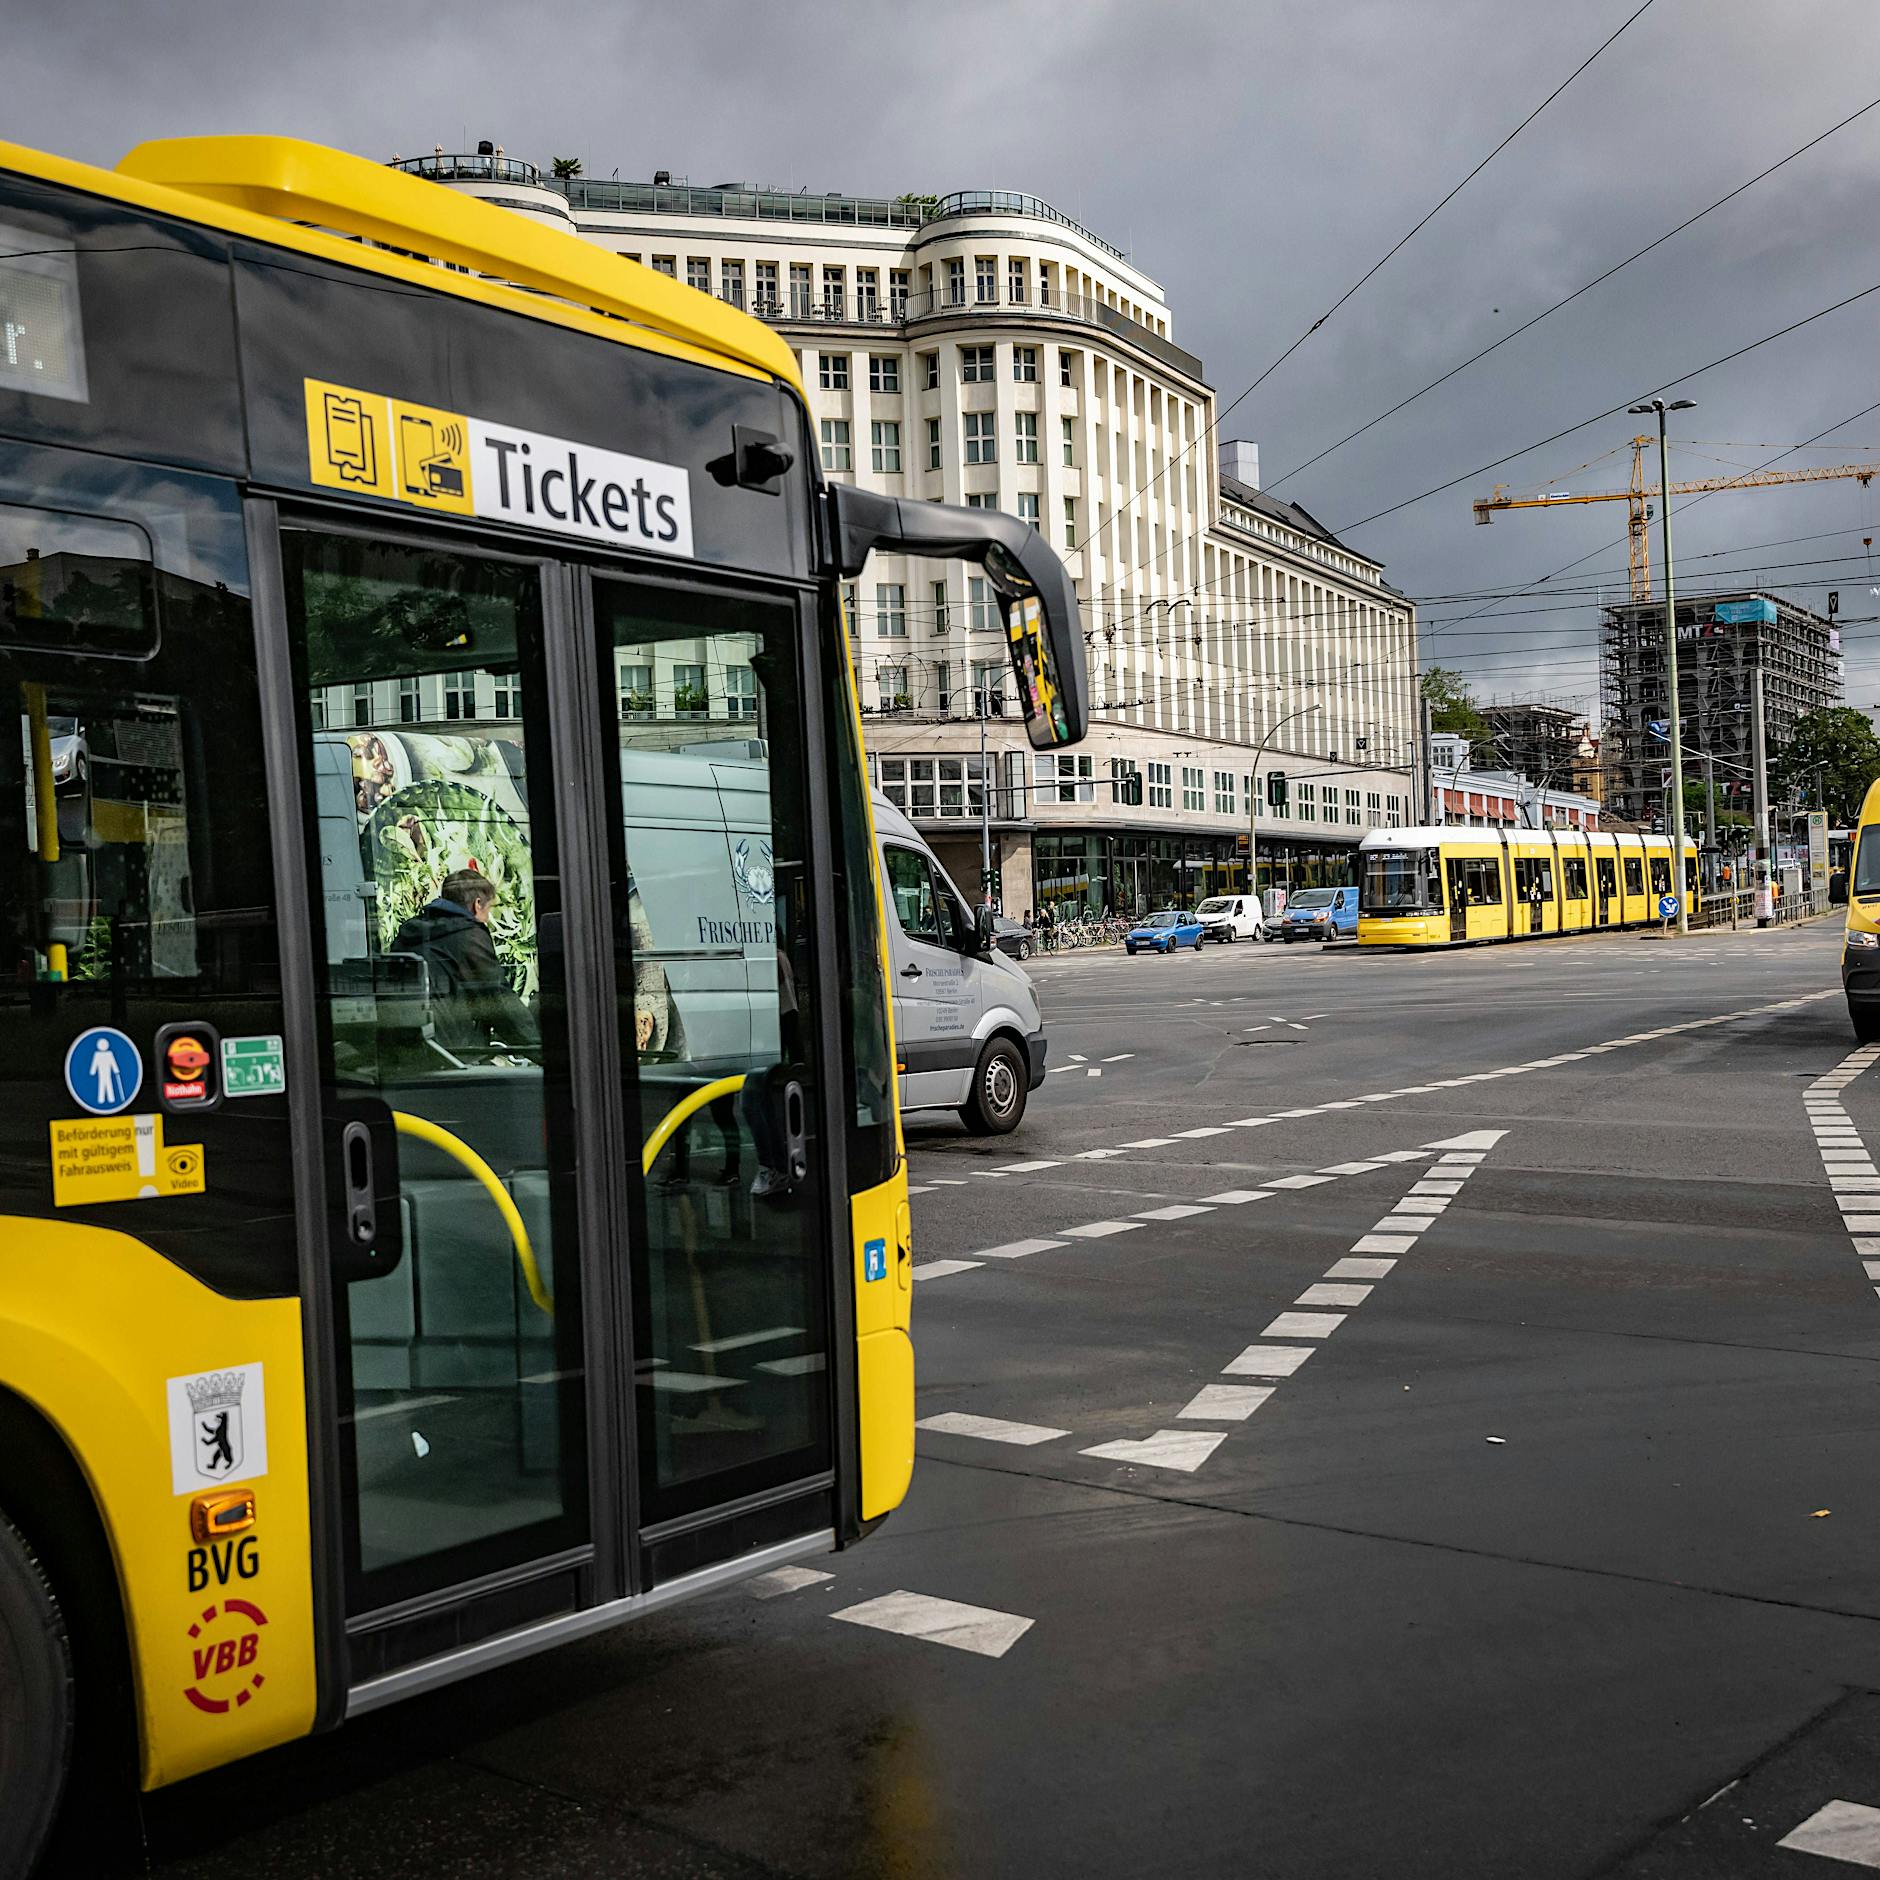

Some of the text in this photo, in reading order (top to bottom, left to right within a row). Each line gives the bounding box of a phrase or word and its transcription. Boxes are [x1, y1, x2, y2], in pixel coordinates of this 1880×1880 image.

[485, 437, 678, 542] Tickets
[697, 916, 775, 943] FRISCHEP
[57, 1126, 154, 1142] Beförderung nur
[58, 1144, 134, 1161] mit gültigem
[59, 1160, 132, 1177] Fahrausweis
[170, 1178, 199, 1190] Video
[188, 1535, 259, 1592] BVG
[193, 1633, 259, 1680] VBB
